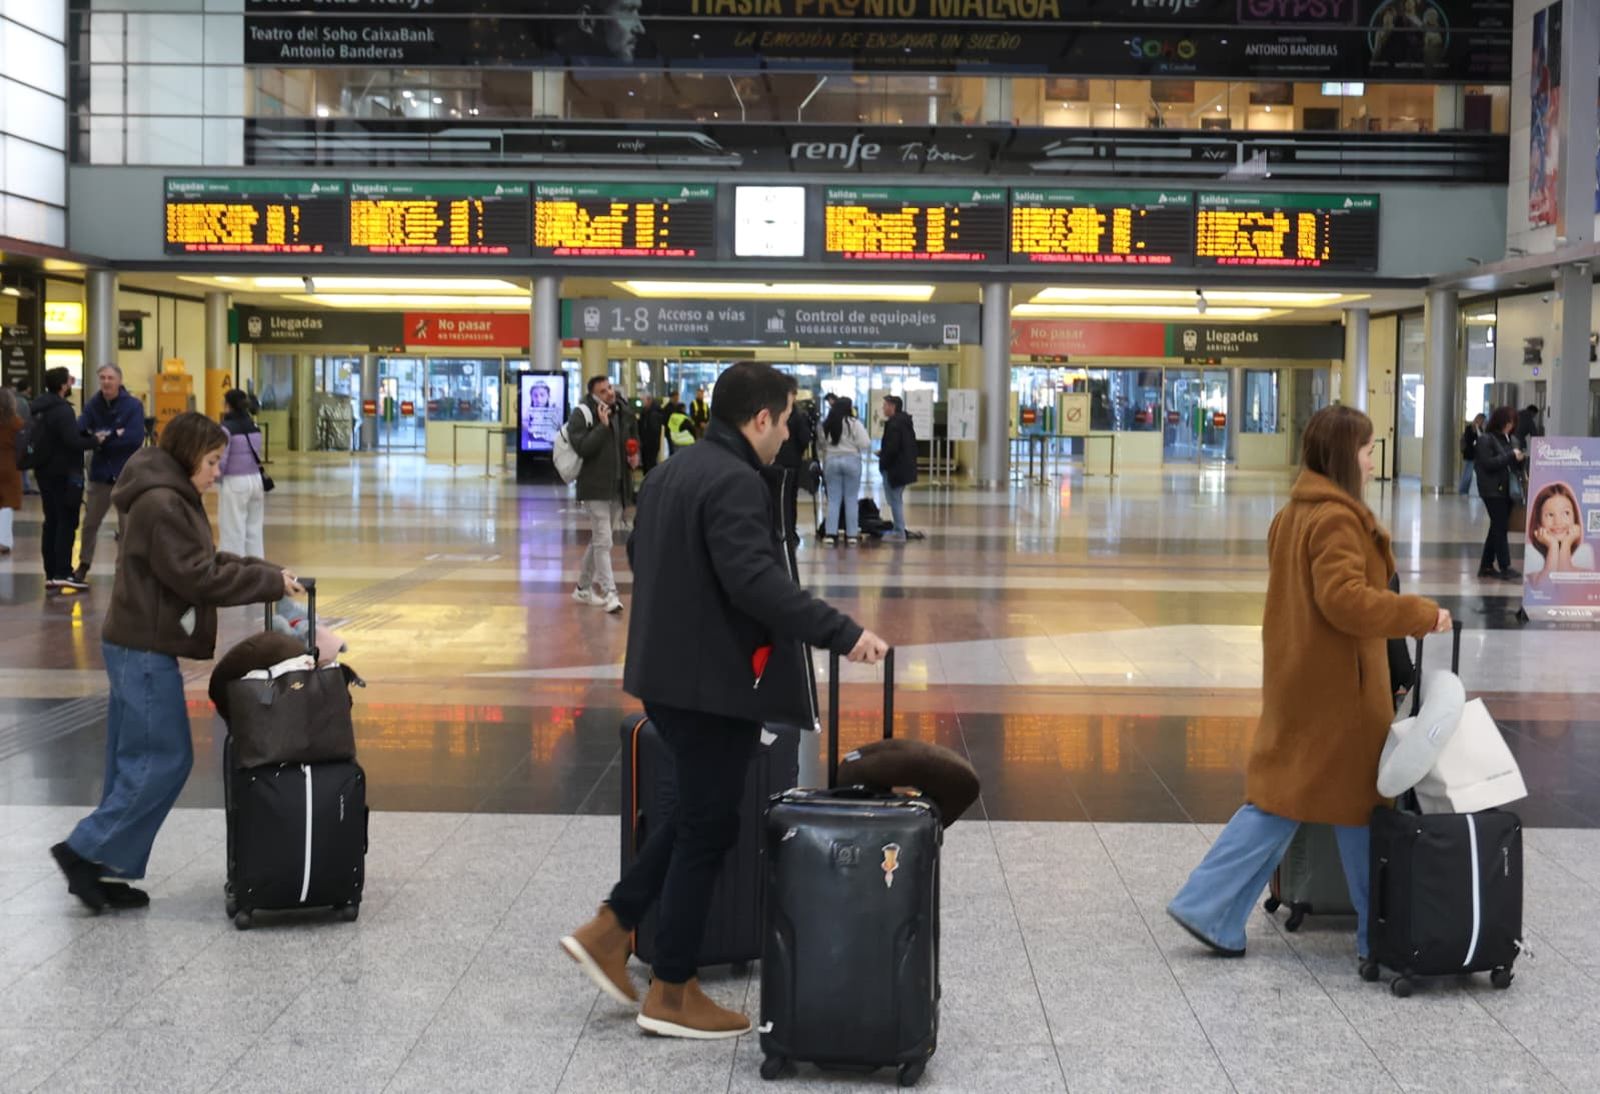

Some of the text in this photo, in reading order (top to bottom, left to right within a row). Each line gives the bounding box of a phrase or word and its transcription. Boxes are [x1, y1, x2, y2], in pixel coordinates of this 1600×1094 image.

[1248, 0, 1344, 17] GYPSY
[250, 26, 434, 42] Teatro del Soho CaixaBank
[838, 32, 863, 48] DE
[941, 33, 962, 49] UN
[967, 32, 1022, 49] SUEÑO
[280, 44, 404, 58] Antonio Banderas
[1245, 44, 1338, 57] ANTONIO BANDERAS
[790, 134, 976, 169] renfe Tu tren
[828, 189, 858, 199] Salidas
[1015, 191, 1044, 201] Salidas
[1200, 195, 1230, 205] Salidas
[611, 306, 649, 332] 1-8
[657, 307, 746, 321] Acceso a vías
[795, 308, 937, 326] Control de equipajes
[270, 316, 323, 331] Llegadas
[438, 318, 492, 333] No pasar
[657, 323, 709, 333] PLATFORMS
[795, 325, 880, 335] LUGGAGE CONTROL
[1030, 327, 1084, 342] No pasar
[1205, 328, 1259, 344] Llegadas
[1206, 344, 1239, 352] ARRIVALS
